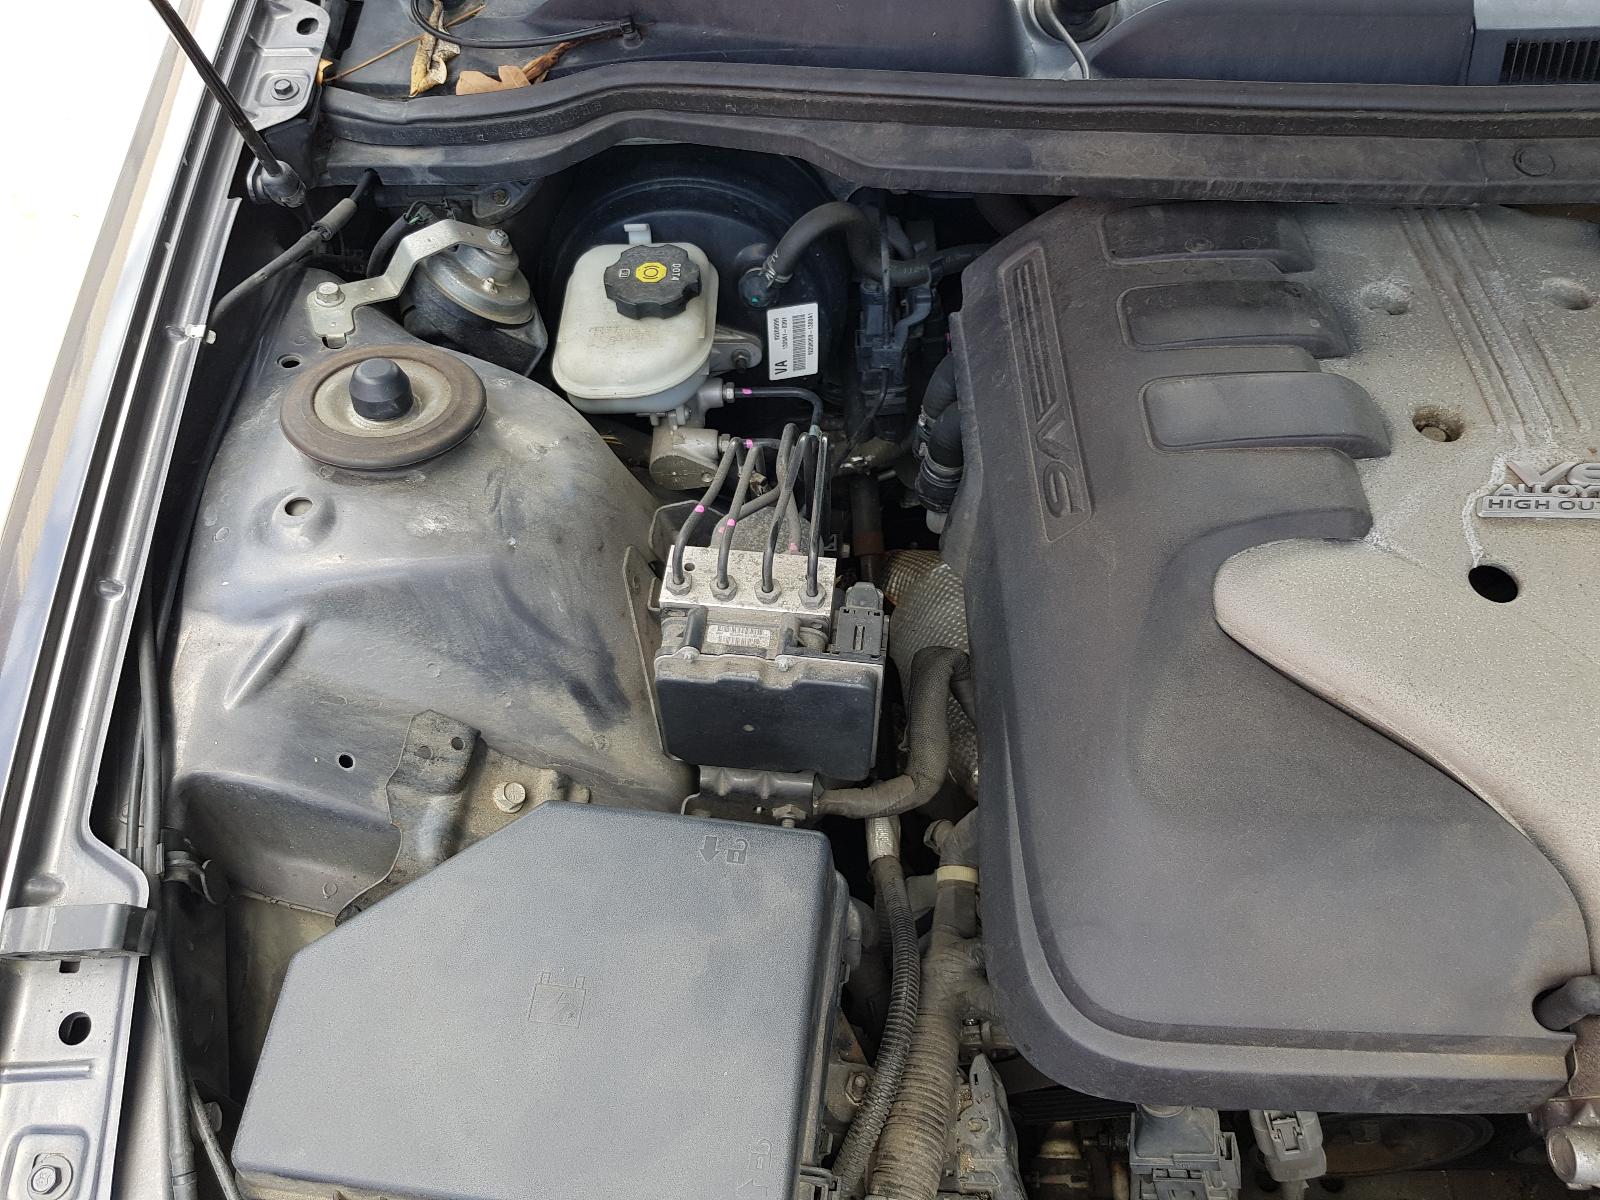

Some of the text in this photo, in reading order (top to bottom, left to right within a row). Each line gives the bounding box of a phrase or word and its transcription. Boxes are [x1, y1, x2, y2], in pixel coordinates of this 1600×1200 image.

[774, 359, 788, 375] VA
[1488, 499, 1600, 511] HIGH OU
